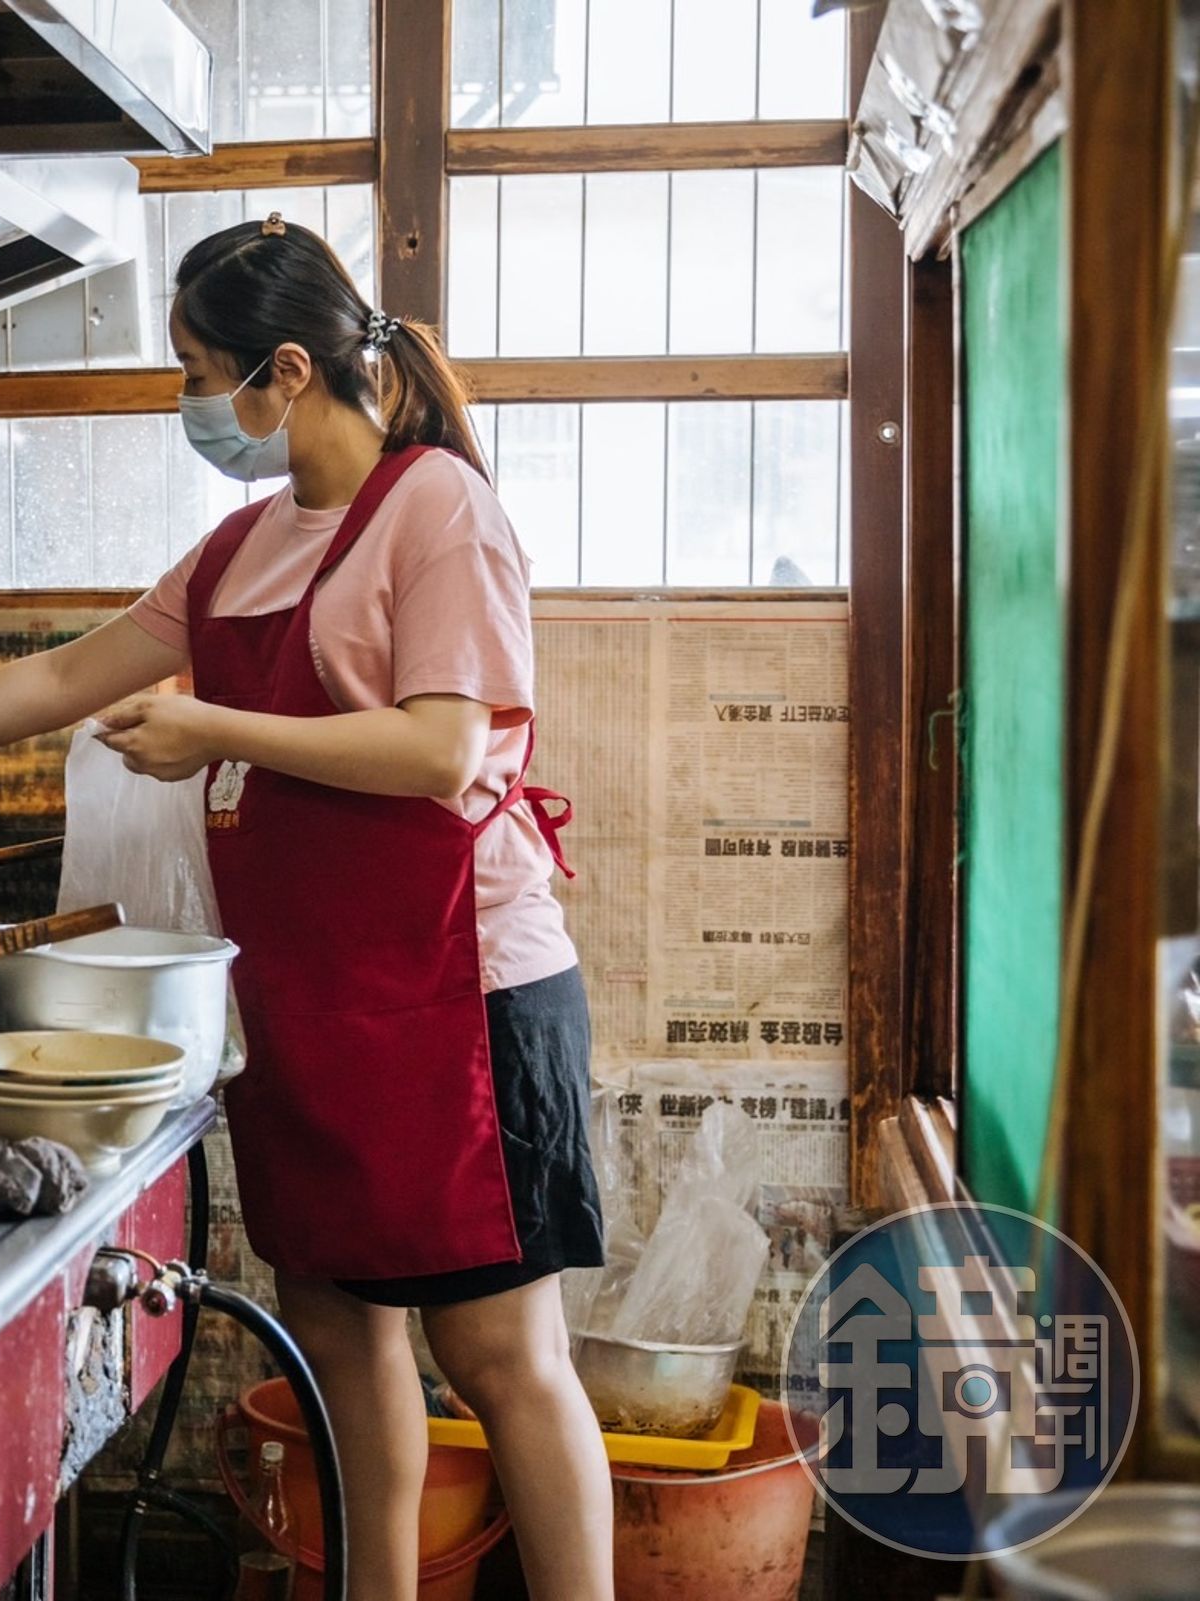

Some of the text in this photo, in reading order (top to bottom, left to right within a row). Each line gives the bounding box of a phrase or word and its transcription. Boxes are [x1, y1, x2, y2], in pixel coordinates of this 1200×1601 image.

[716, 705, 772, 721] 資金湧入
[705, 839, 771, 856] 有利可圖
[666, 1020, 844, 1046] 台股基金 績效亮眼
